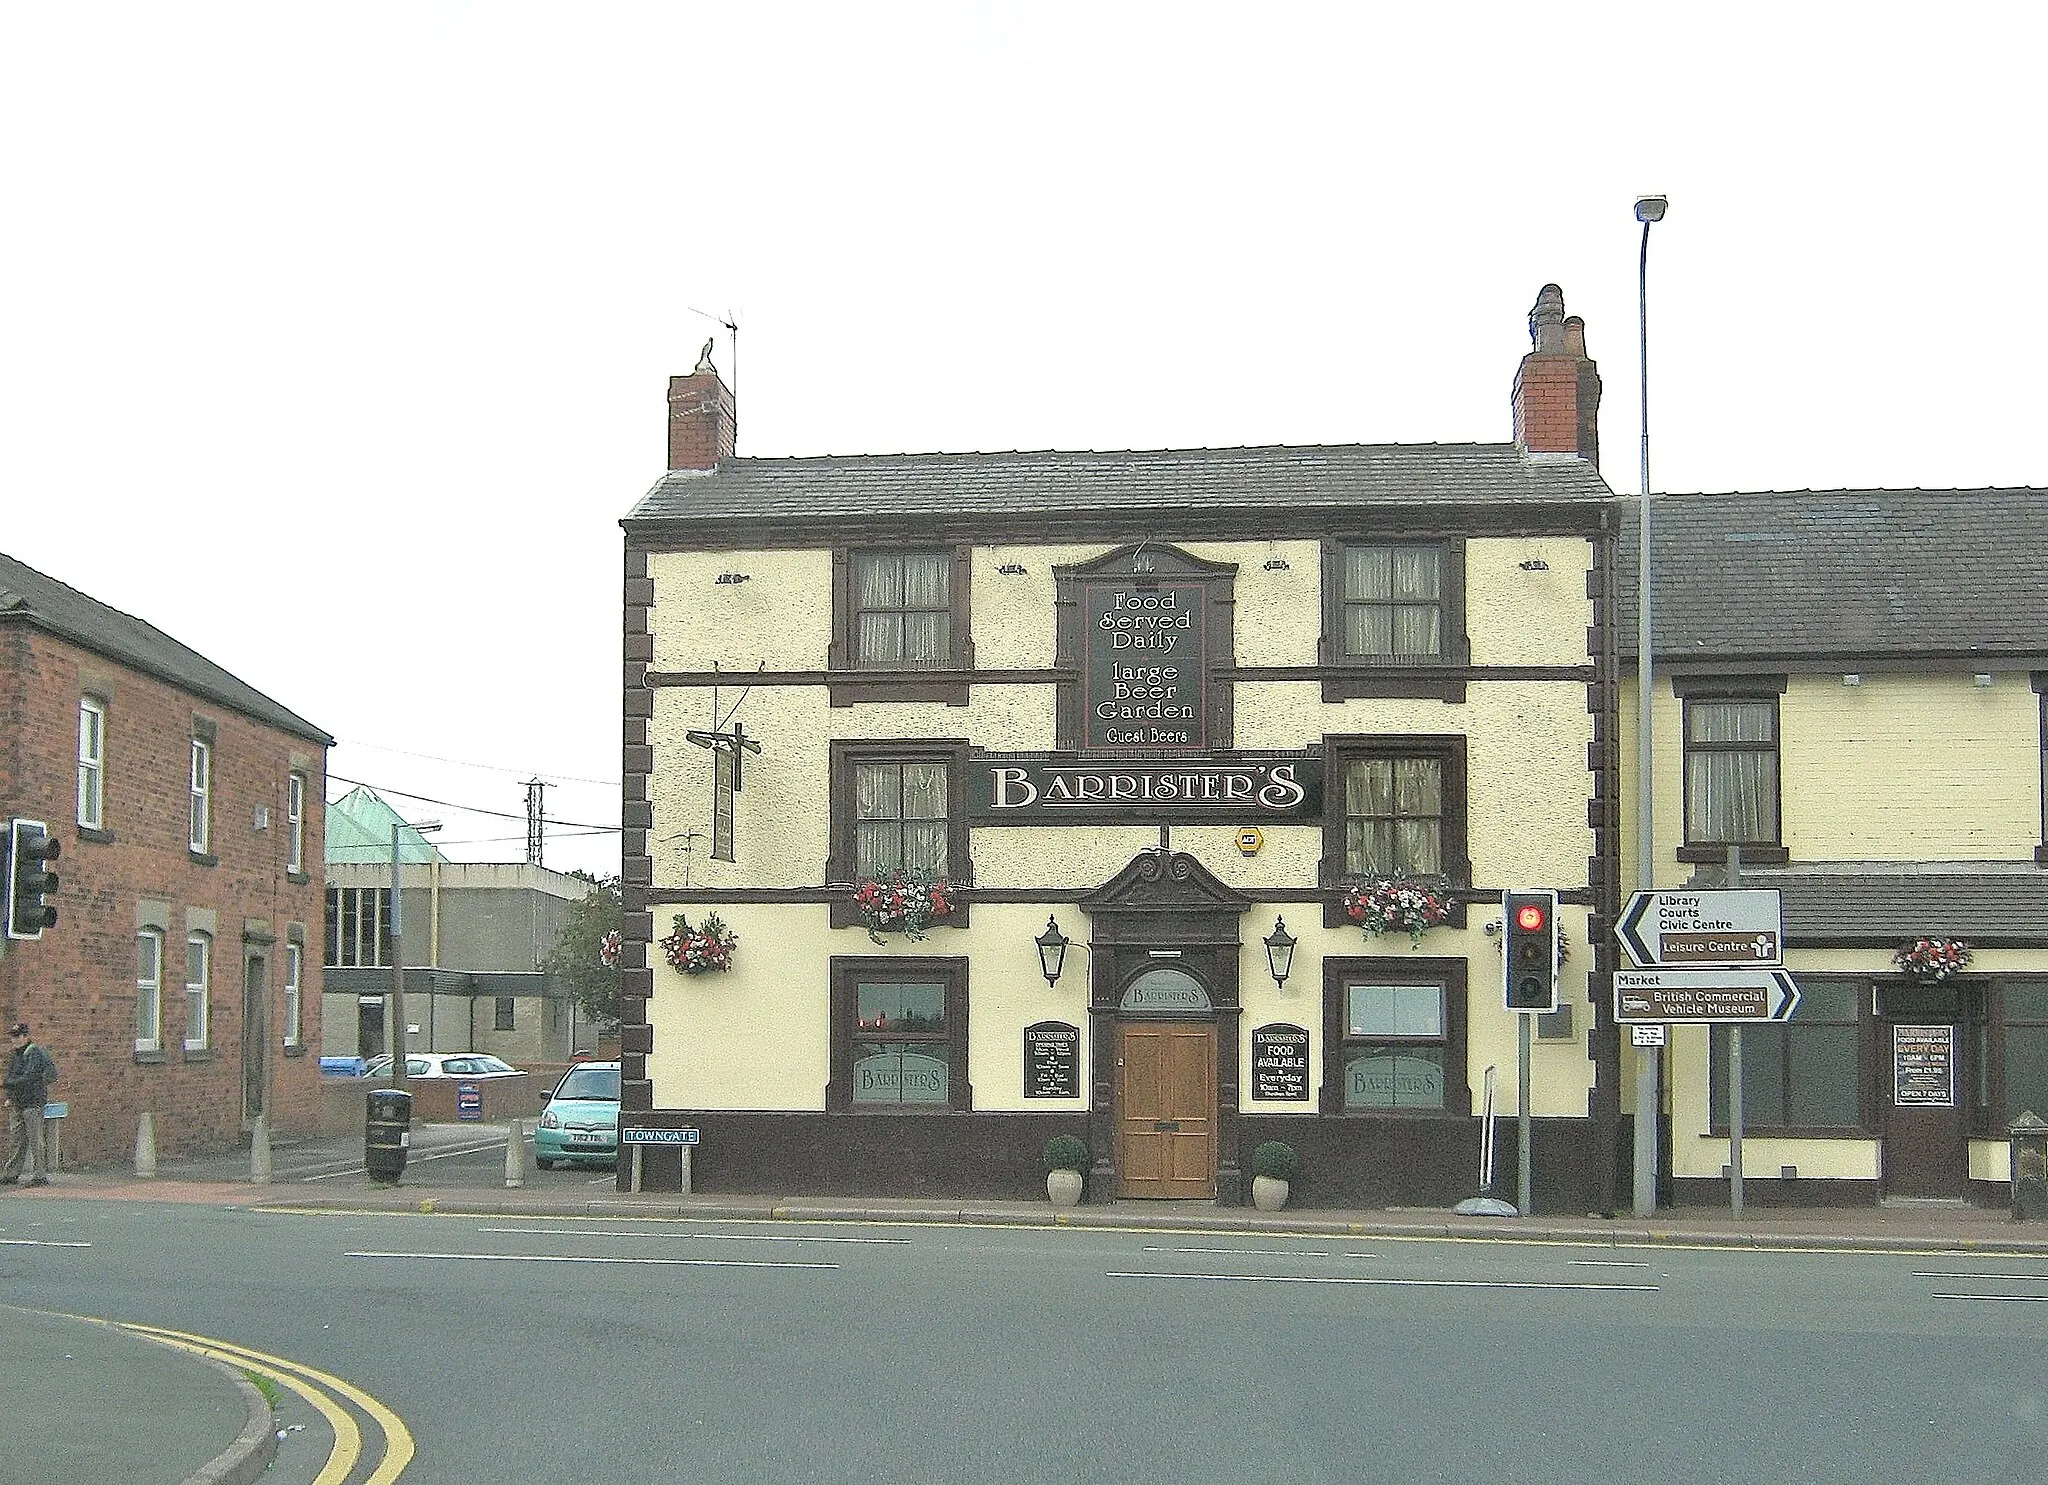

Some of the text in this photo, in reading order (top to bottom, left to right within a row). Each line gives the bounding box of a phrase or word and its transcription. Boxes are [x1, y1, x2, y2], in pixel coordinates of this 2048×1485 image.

[1114, 591, 1176, 610] Food
[1098, 611, 1191, 630] Served
[1111, 632, 1179, 654] Daily
[1112, 661, 1179, 686] large
[1114, 683, 1177, 699] Beer
[1096, 702, 1194, 719] Garden
[1106, 728, 1188, 743] Guest Beers
[990, 764, 1305, 809] BARRISTER'S
[1659, 896, 1700, 907] Library
[1659, 908, 1700, 918] Courts
[1659, 920, 1733, 930] Civic Centre
[1663, 941, 1748, 952] Leisure Centre
[1618, 975, 1661, 986] Market
[1654, 991, 1765, 1001] British Commercial
[1662, 1004, 1756, 1014] Vehicle Museum
[1267, 1045, 1294, 1056] FOOD
[1898, 1044, 1949, 1053] EVERY DAY
[1257, 1058, 1305, 1068] AVAILABLE
[1260, 1073, 1302, 1082] Everyday
[628, 1131, 696, 1142] TOWNGATE
